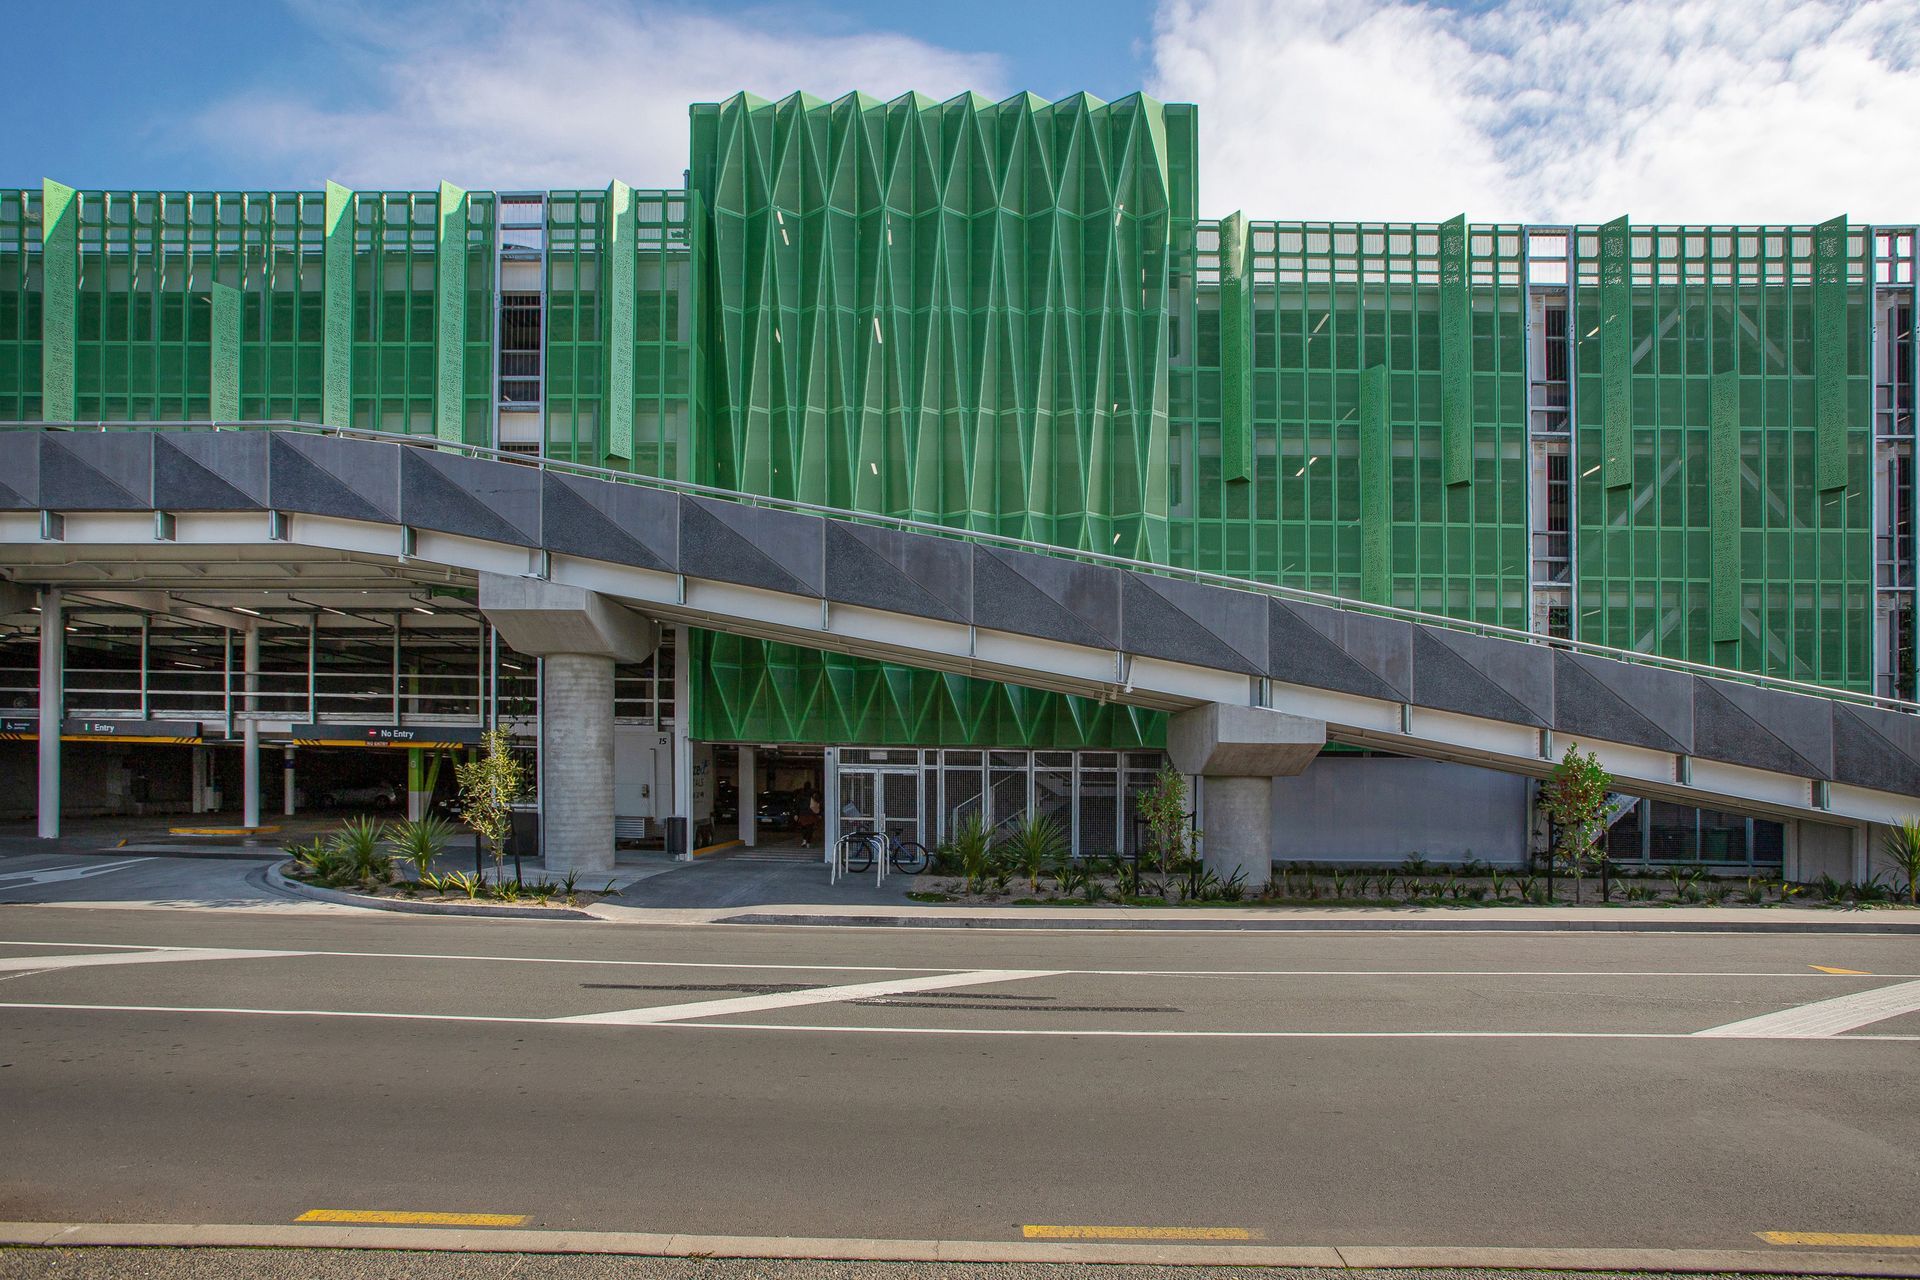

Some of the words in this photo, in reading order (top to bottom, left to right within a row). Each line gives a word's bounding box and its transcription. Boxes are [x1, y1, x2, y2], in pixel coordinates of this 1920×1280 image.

[94, 723, 115, 733] Entry
[381, 729, 392, 738] No
[393, 729, 414, 739] Entry
[658, 737, 667, 745] 15
